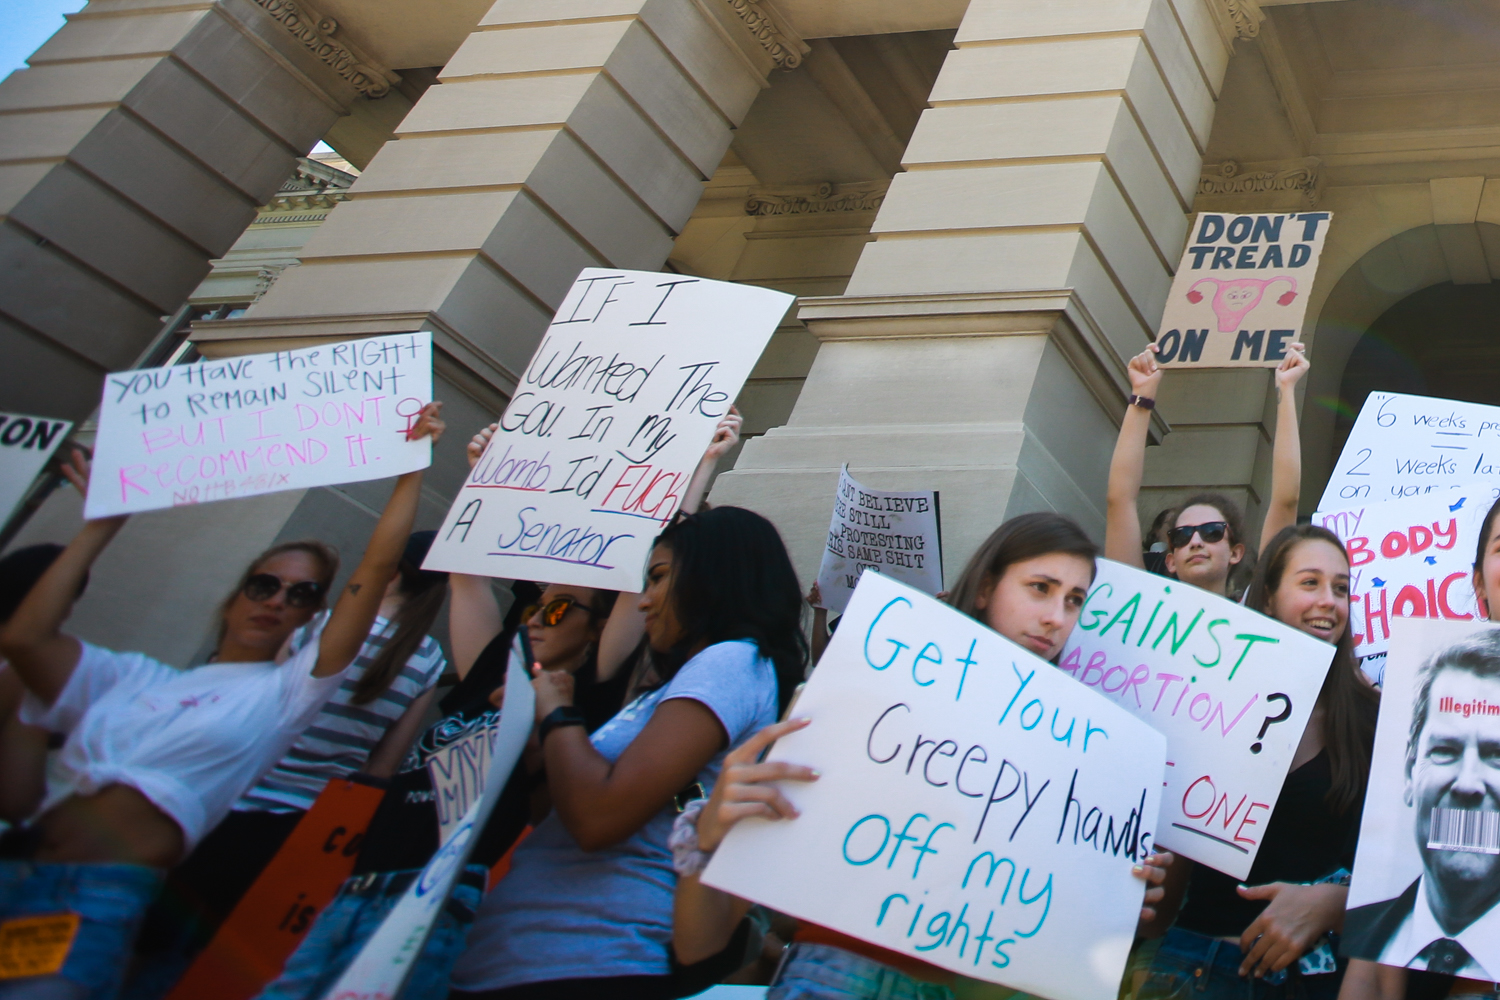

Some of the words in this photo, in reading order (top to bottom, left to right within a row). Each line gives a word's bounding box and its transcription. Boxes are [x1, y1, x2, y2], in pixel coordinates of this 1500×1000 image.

[1196, 212, 1329, 244] DON'T
[1188, 244, 1312, 270] TREAD
[552, 275, 635, 325] IF
[629, 279, 700, 326] I
[1155, 329, 1209, 364] ON
[1230, 329, 1295, 362] ME
[112, 368, 172, 403] YOU
[526, 335, 666, 403] Wanted
[665, 361, 729, 417] The
[0, 416, 64, 450] ON
[141, 415, 232, 455] BUT
[250, 409, 281, 441] I
[296, 396, 386, 432] DONT
[568, 405, 613, 442] In
[471, 444, 551, 487] Womb
[1346, 448, 1372, 476] 2
[858, 490, 929, 513] BELIEVE
[1340, 485, 1371, 499] on
[446, 499, 482, 542] A
[499, 507, 635, 566] Senator
[840, 523, 925, 550] PROTESTING
[849, 507, 890, 529] STILL
[848, 545, 882, 564] SAME
[886, 550, 924, 569] SHIT
[1346, 518, 1457, 567] BODY
[863, 596, 978, 701] Get
[999, 661, 1109, 753] Your
[867, 703, 1051, 844] Creepy
[1181, 775, 1269, 845] ONE
[842, 812, 956, 879] Off
[961, 850, 1053, 938] my
[876, 890, 1017, 970] rights
